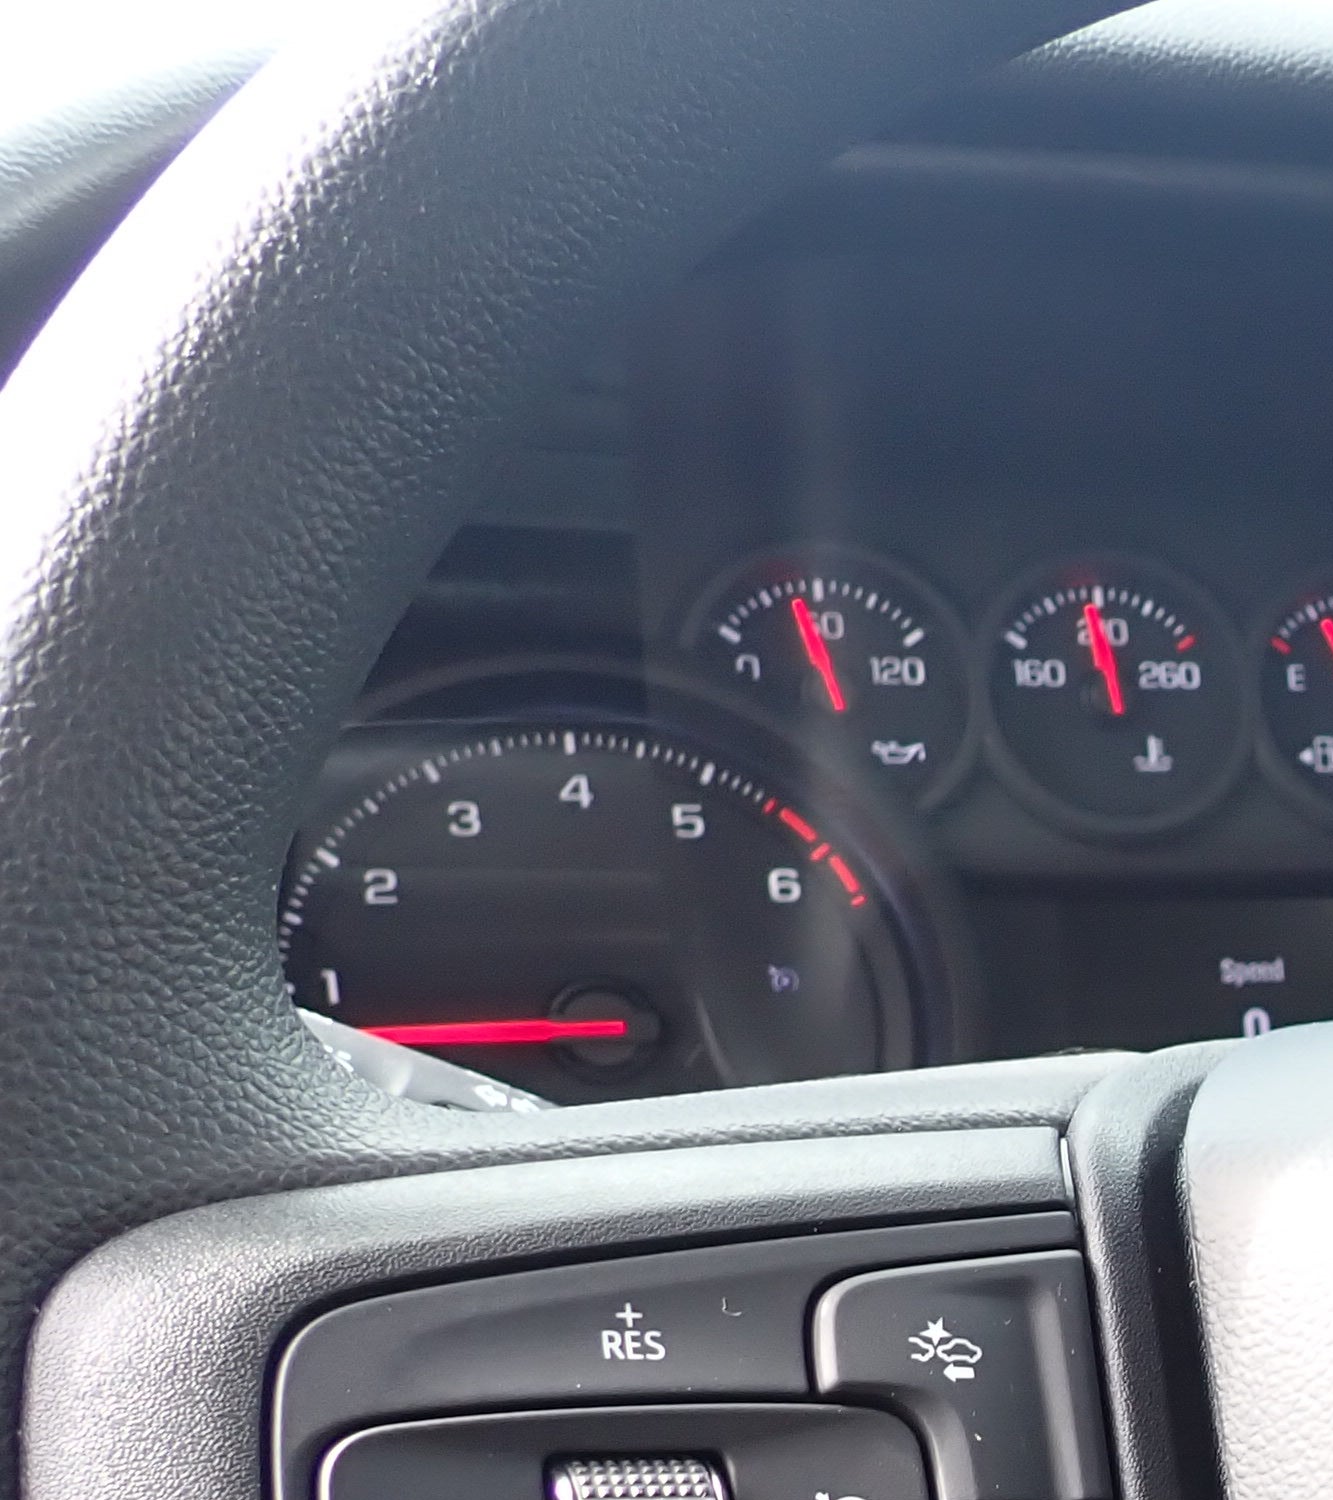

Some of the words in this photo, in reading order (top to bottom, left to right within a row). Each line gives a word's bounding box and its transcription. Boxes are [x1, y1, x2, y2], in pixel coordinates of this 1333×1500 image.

[806, 611, 845, 640] 0
[870, 656, 926, 686] 120
[1014, 659, 1066, 688] 160
[1138, 661, 1201, 690] 260
[1286, 664, 1306, 693] E
[559, 774, 594, 809] 4
[447, 800, 482, 837] 3
[671, 803, 706, 839] 5
[363, 868, 399, 905] 2
[767, 867, 802, 903] 6
[320, 967, 341, 1006] 1
[1219, 957, 1286, 987] Speed
[601, 1329, 666, 1361] RES
